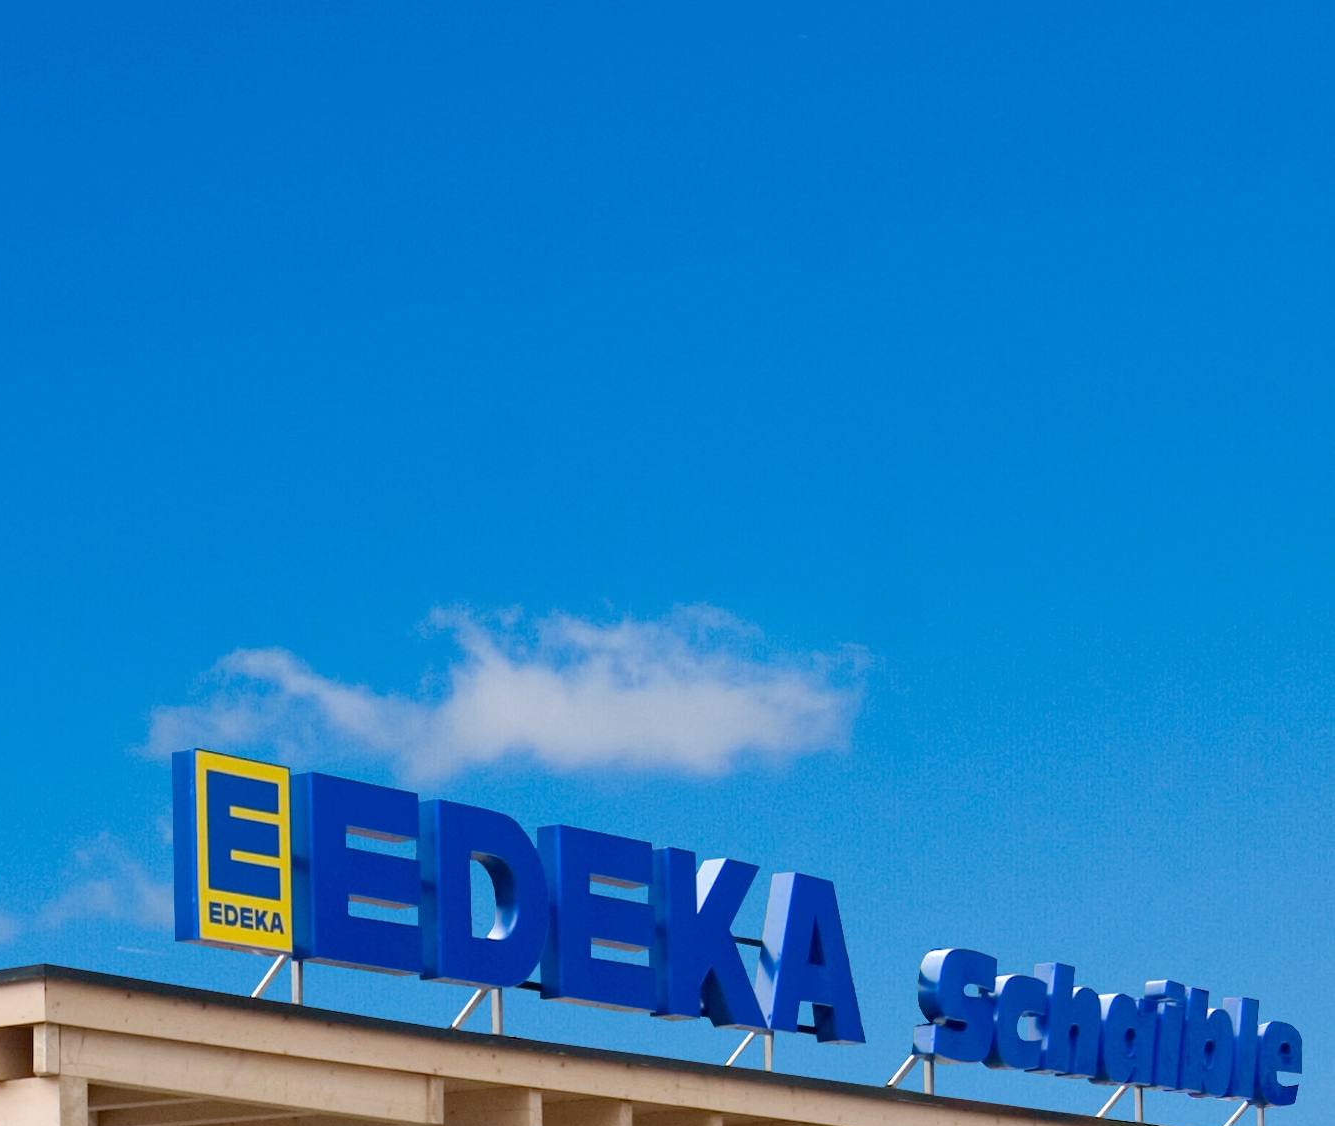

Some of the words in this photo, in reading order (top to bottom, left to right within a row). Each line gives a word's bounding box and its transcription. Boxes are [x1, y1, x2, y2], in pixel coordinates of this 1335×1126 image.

[208, 901, 285, 935] EDEKA
[292, 772, 866, 1045] EDEKA
[912, 948, 1302, 1107] Schaible
